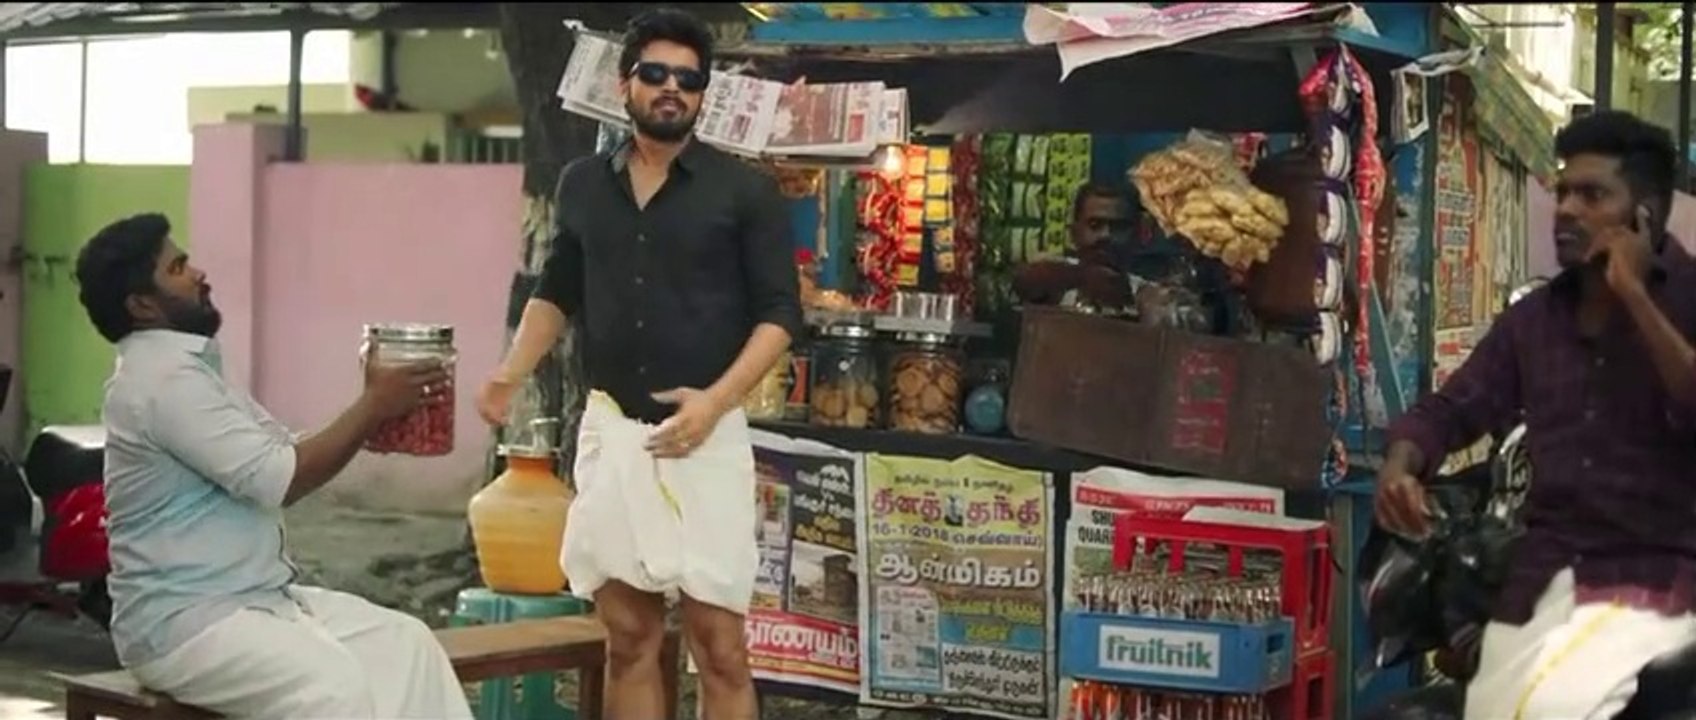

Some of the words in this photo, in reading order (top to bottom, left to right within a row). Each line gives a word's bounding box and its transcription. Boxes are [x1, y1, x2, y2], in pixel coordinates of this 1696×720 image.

[872, 487, 942, 524] தினத்
[967, 495, 1041, 528] தந்தி
[875, 551, 1041, 587] ஆன்மிகம்
[1105, 635, 1212, 669] fruitnik
